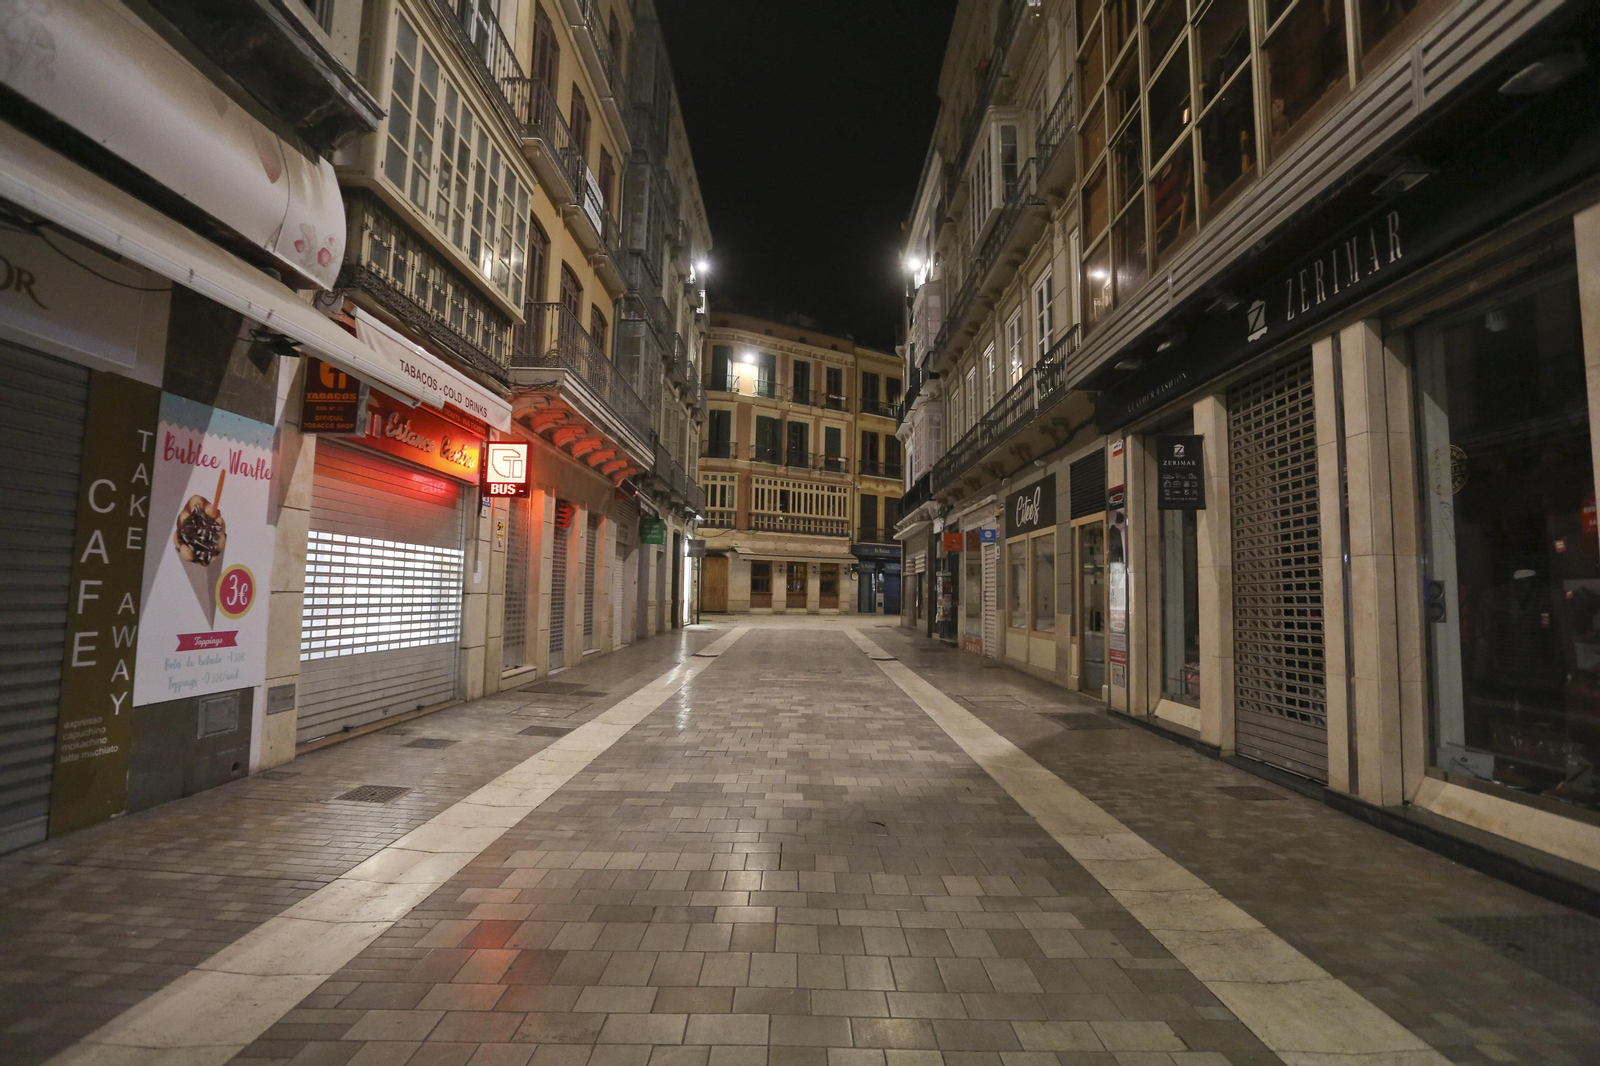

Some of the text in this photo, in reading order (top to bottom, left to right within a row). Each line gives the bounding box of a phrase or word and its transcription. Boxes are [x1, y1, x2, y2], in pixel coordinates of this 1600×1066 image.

[1286, 211, 1402, 321] ZERIMAR
[306, 392, 357, 400] TABACOS
[400, 359, 438, 391] TABACOS
[443, 385, 463, 404] COLD
[465, 397, 488, 418] DRINKS
[163, 430, 220, 469] Bublee
[385, 412, 475, 469] Estanco Centro
[126, 429, 153, 550] TAKE
[490, 483, 516, 494] BUS
[71, 478, 117, 668] CAFE
[226, 574, 248, 606] 3€
[194, 636, 223, 647] Toppings
[110, 592, 137, 716] AWAY
[185, 656, 195, 667] de
[198, 653, 222, 666] helado
[168, 675, 198, 693] Toppings
[63, 716, 103, 729] expresso
[62, 726, 107, 741] capuchino
[61, 737, 108, 752] mokachino
[60, 753, 80, 763] latte
